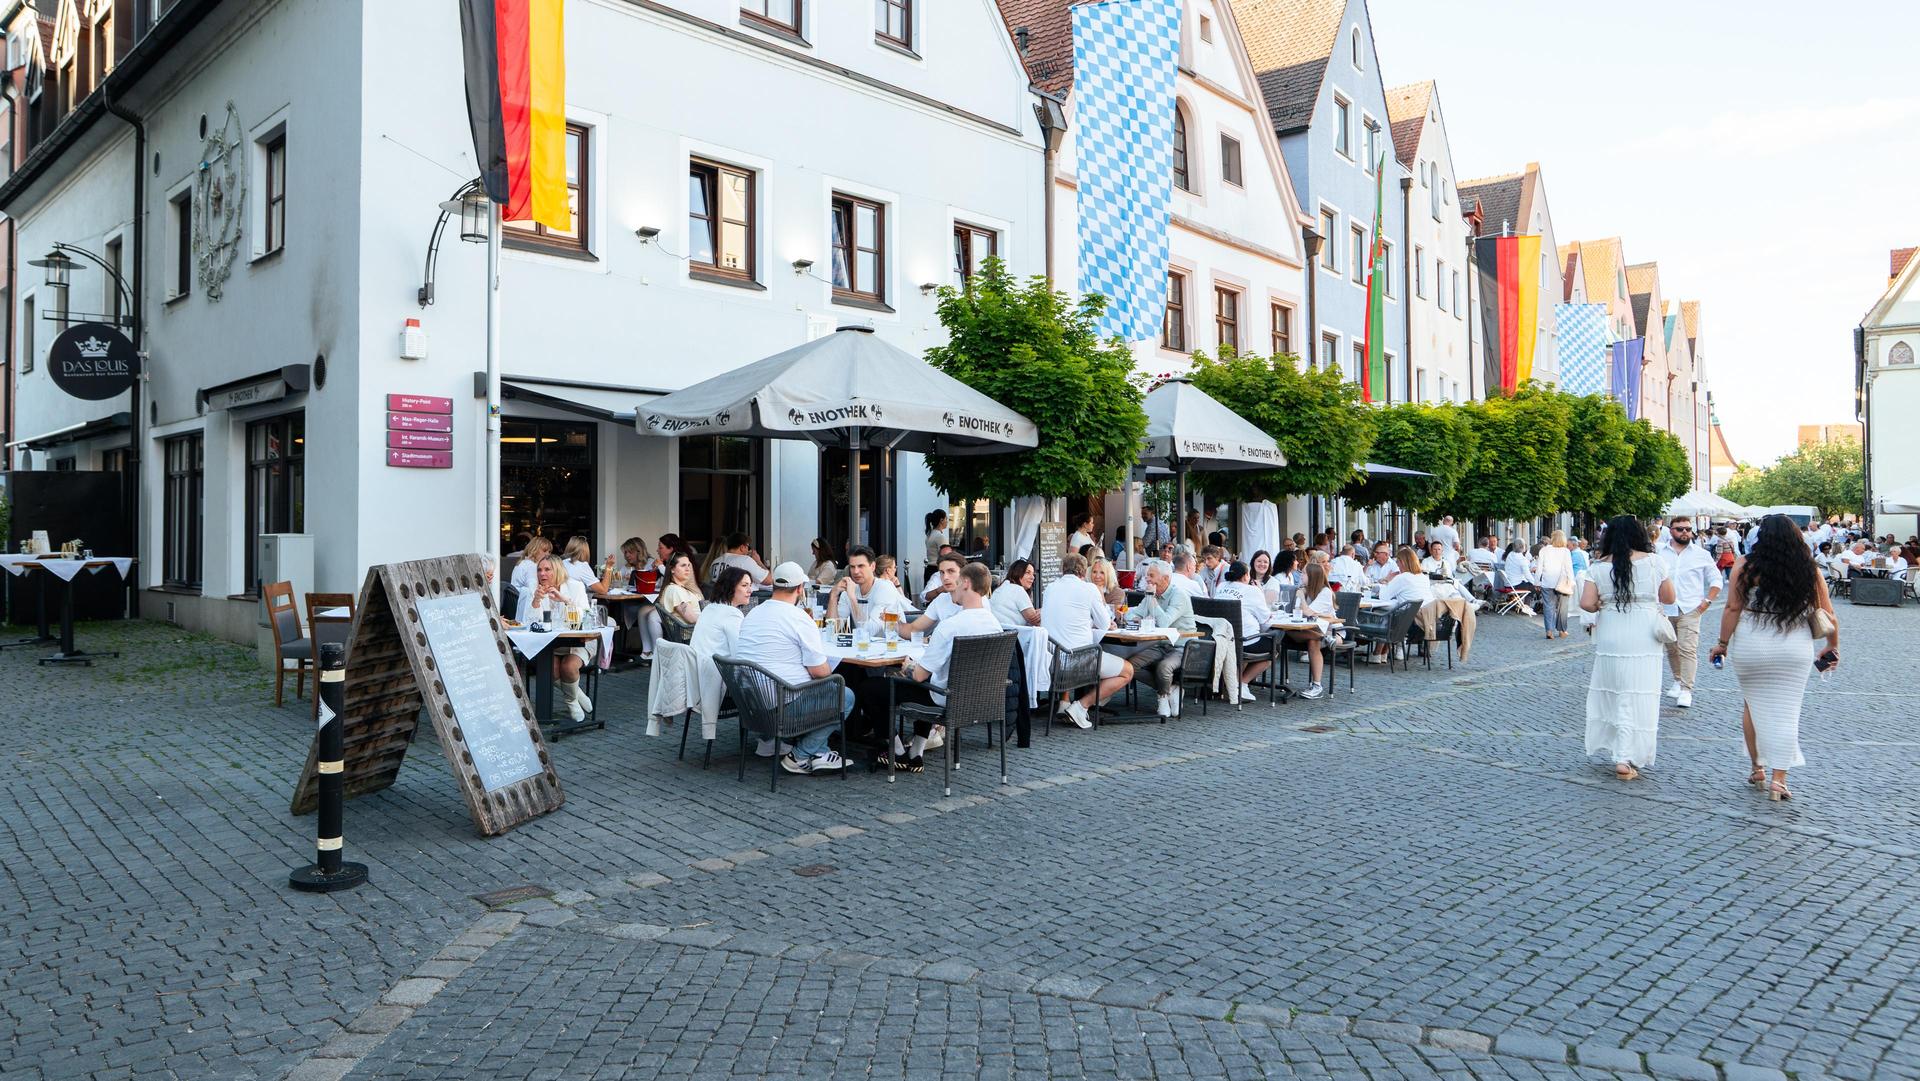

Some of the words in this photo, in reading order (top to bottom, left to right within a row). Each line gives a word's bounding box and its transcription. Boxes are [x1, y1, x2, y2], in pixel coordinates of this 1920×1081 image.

[63, 361, 92, 372] DAS
[94, 360, 129, 371] LOUIS
[808, 404, 868, 424] ENOTHEK
[958, 415, 1001, 435] ENOTHEK
[1192, 442, 1217, 454] ENOTHEK
[1247, 448, 1273, 459] ENOTHEK
